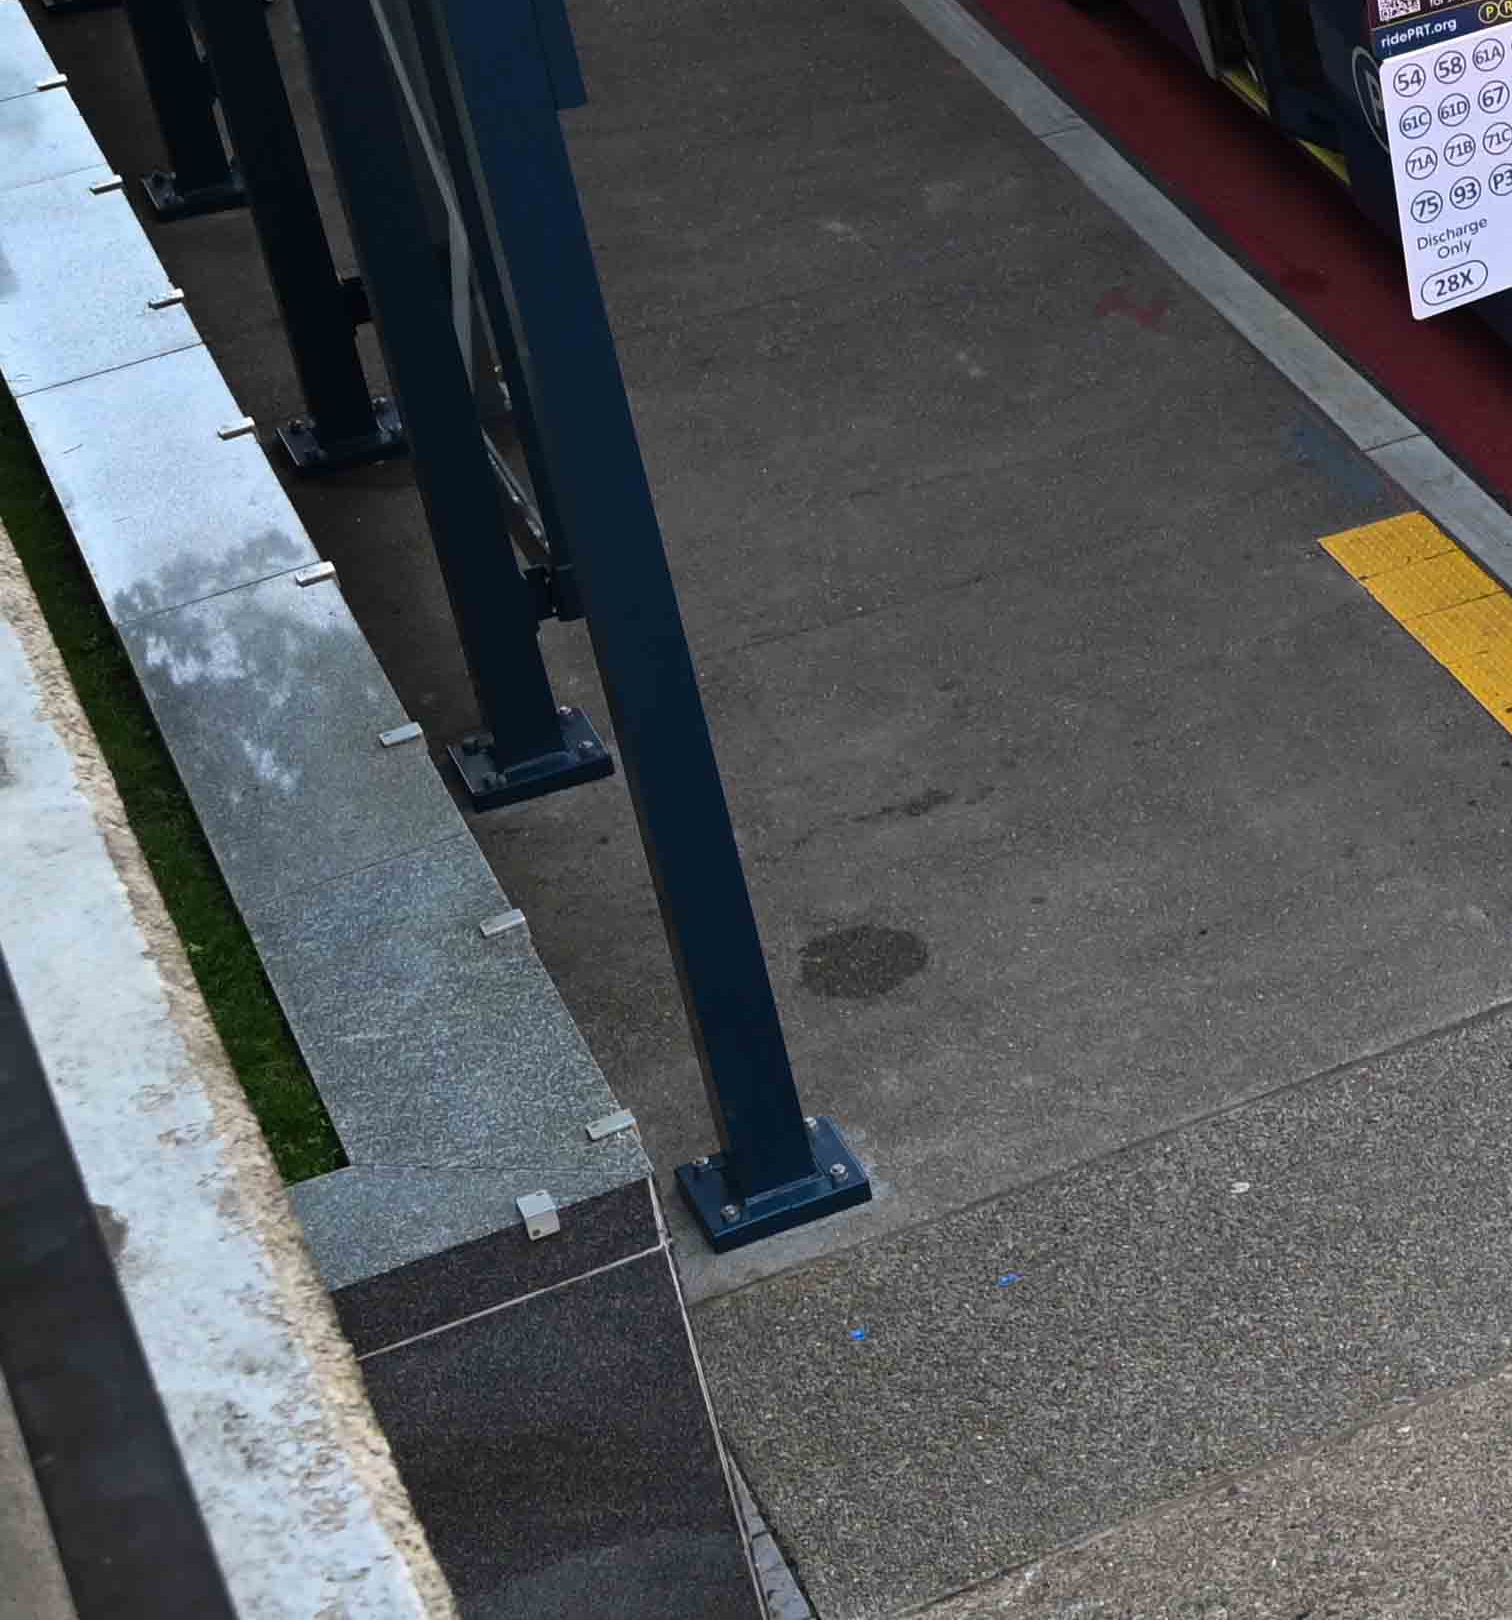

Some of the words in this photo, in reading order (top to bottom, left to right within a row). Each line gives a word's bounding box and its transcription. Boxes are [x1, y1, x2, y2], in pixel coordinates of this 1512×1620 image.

[1381, 18, 1457, 49] ridePRT.org
[1397, 69, 1422, 92] 54
[1438, 56, 1463, 79] 58
[1474, 45, 1501, 65] 61A
[1402, 111, 1429, 132] 61C
[1440, 100, 1467, 120] 61D
[1482, 86, 1505, 108] 67
[1408, 154, 1435, 173] 71A
[1447, 140, 1473, 160] 71B
[1486, 128, 1511, 149] 71C
[1415, 195, 1439, 218] 75
[1453, 181, 1477, 205] 93
[1417, 218, 1488, 250] Discharge
[1437, 239, 1472, 260] Only
[1435, 268, 1474, 297] 28X
